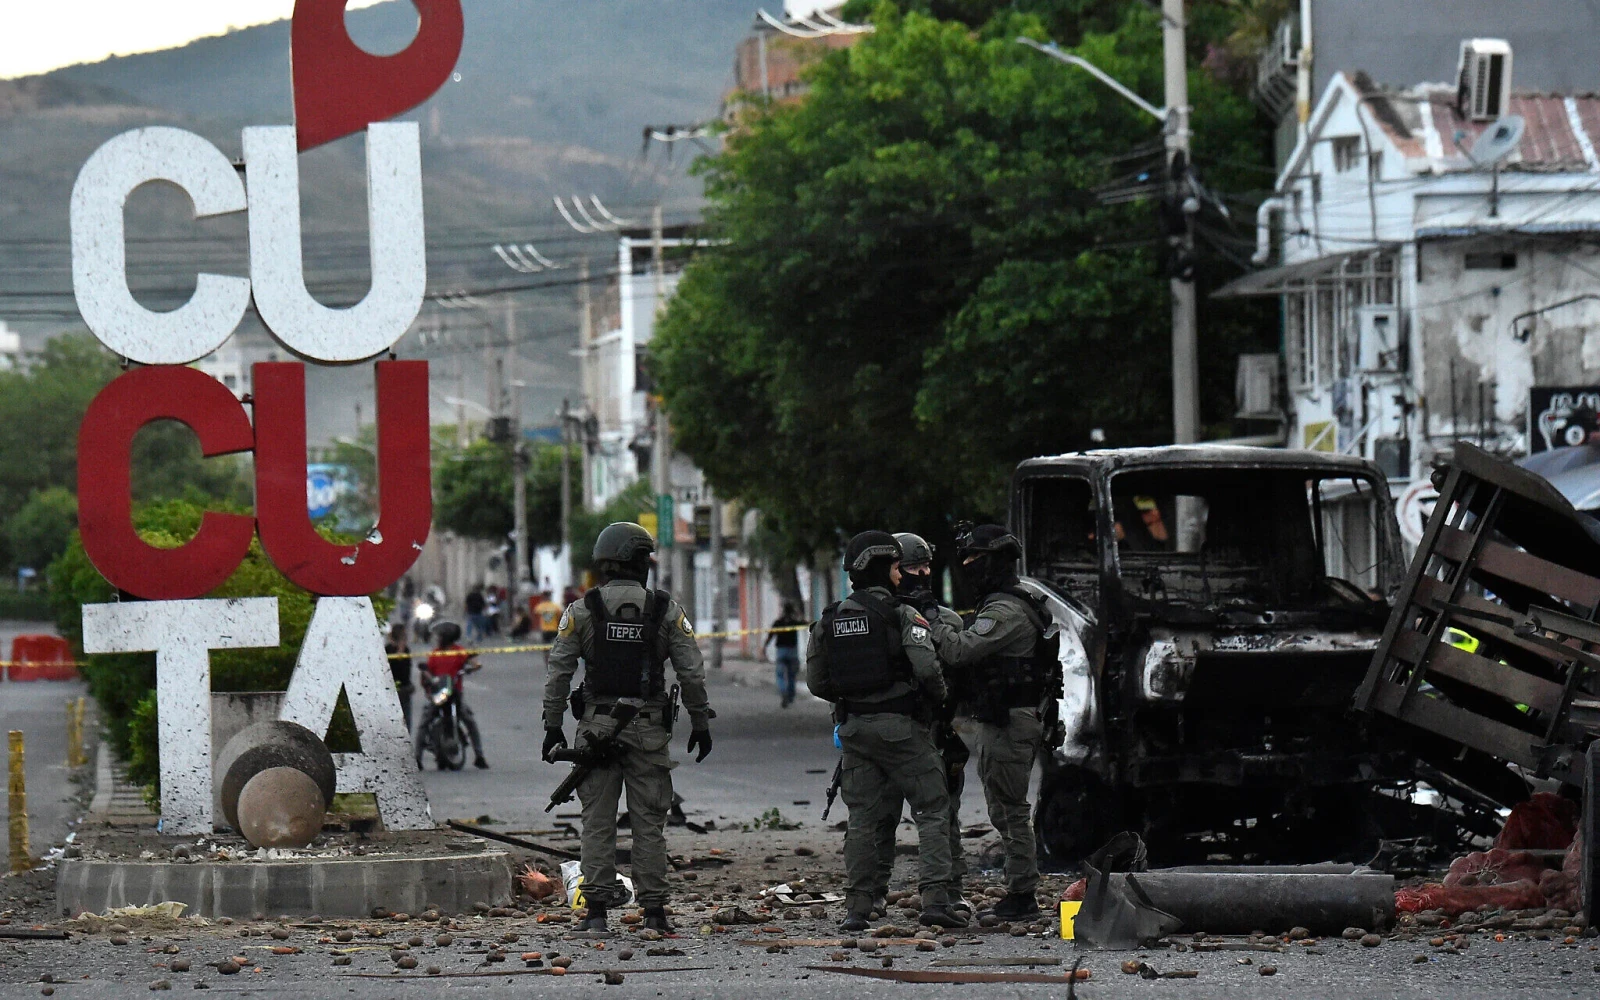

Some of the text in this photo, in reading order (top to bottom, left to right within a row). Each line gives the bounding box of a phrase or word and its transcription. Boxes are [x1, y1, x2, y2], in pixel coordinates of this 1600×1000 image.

[77, 360, 432, 599] CU
[82, 596, 435, 836] TA
[610, 625, 643, 640] TEPEX
